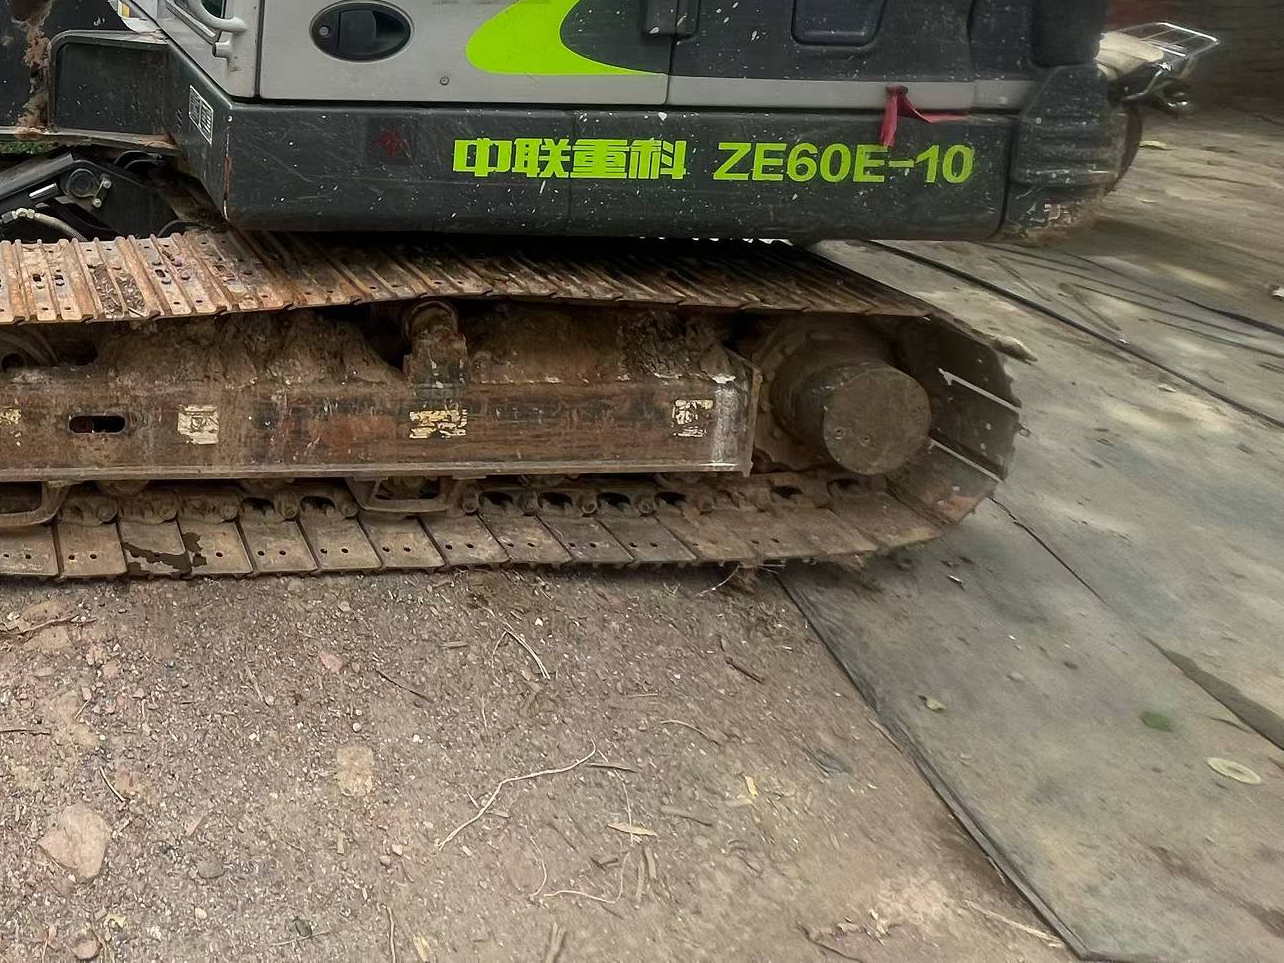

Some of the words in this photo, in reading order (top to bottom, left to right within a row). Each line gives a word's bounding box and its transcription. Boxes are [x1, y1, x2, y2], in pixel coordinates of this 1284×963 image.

[452, 137, 687, 180] 中联重科
[713, 141, 975, 184] ZE60E-10
